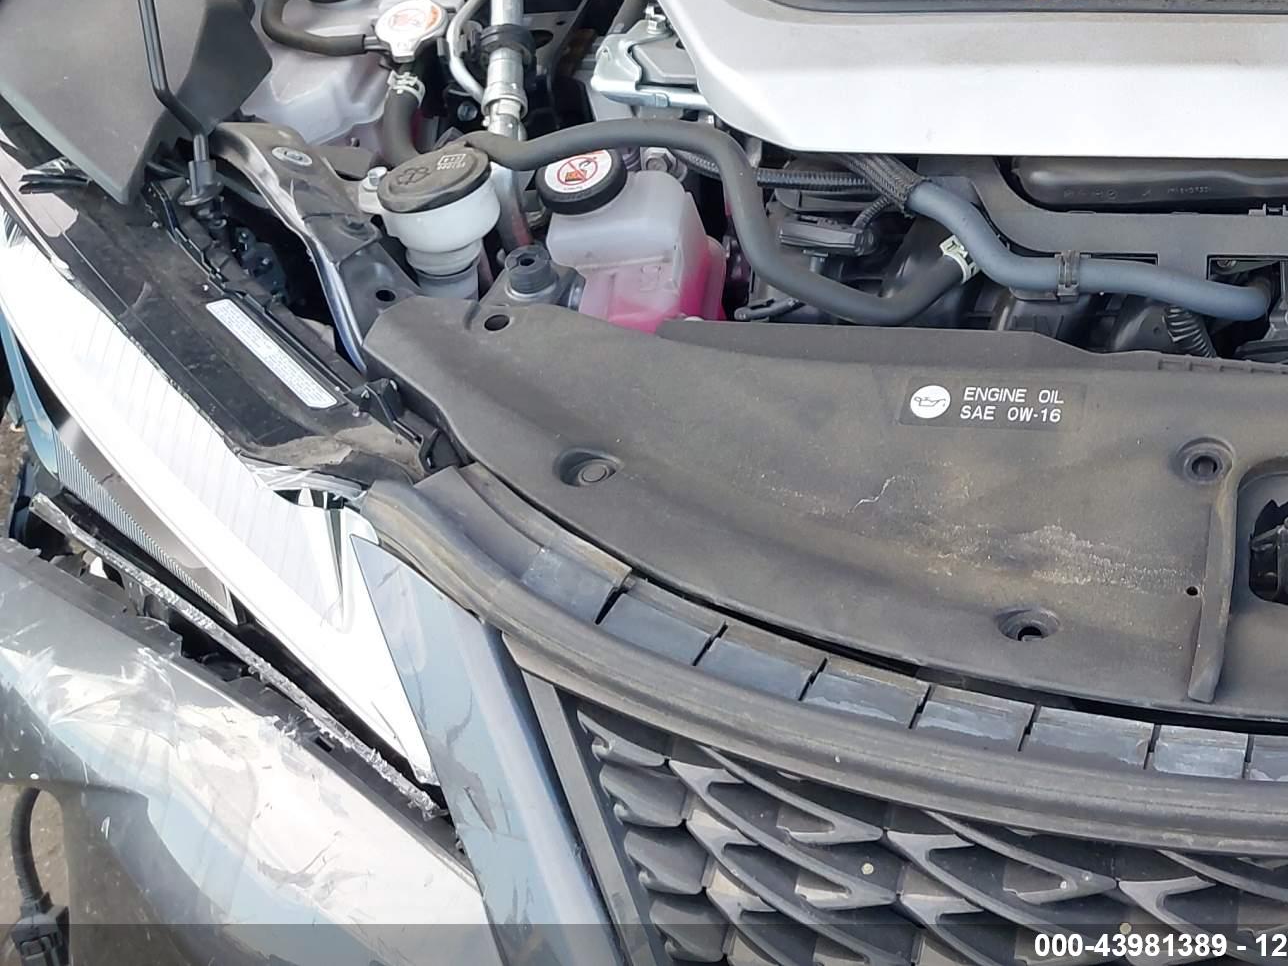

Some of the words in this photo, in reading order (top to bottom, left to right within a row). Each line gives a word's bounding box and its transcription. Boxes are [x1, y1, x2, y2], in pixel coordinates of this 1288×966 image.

[963, 386, 1027, 403] ENGINE
[1038, 389, 1064, 404] OIL
[959, 405, 996, 421] SAE
